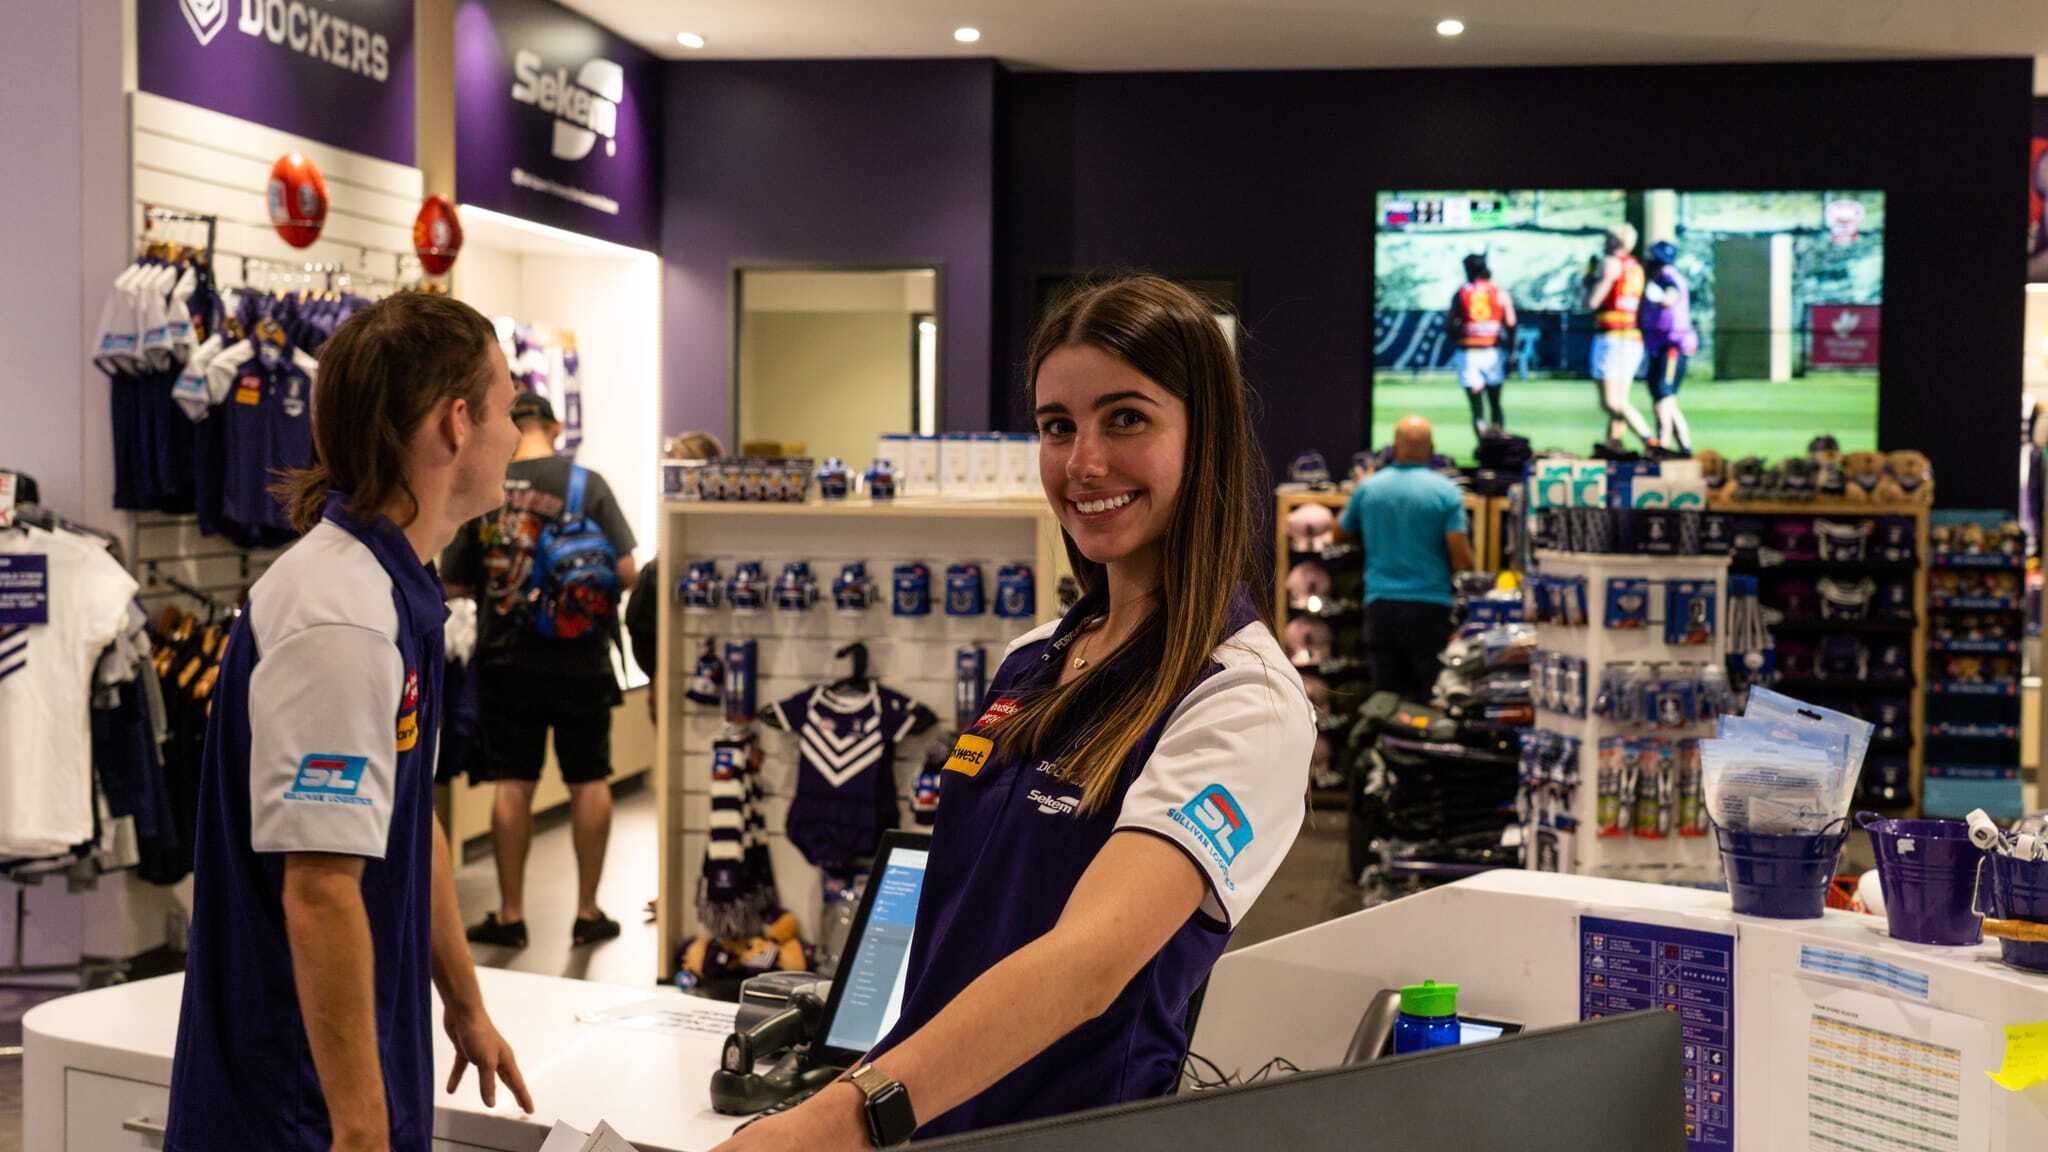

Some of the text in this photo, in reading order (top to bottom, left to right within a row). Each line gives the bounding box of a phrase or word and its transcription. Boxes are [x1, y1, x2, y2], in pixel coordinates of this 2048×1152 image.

[238, 0, 389, 82] DOCKERS
[300, 769, 356, 790] SL
[1026, 789, 1073, 814] Sekem
[1166, 807, 1209, 849] SULLIVAN
[1194, 797, 1235, 860] SL
